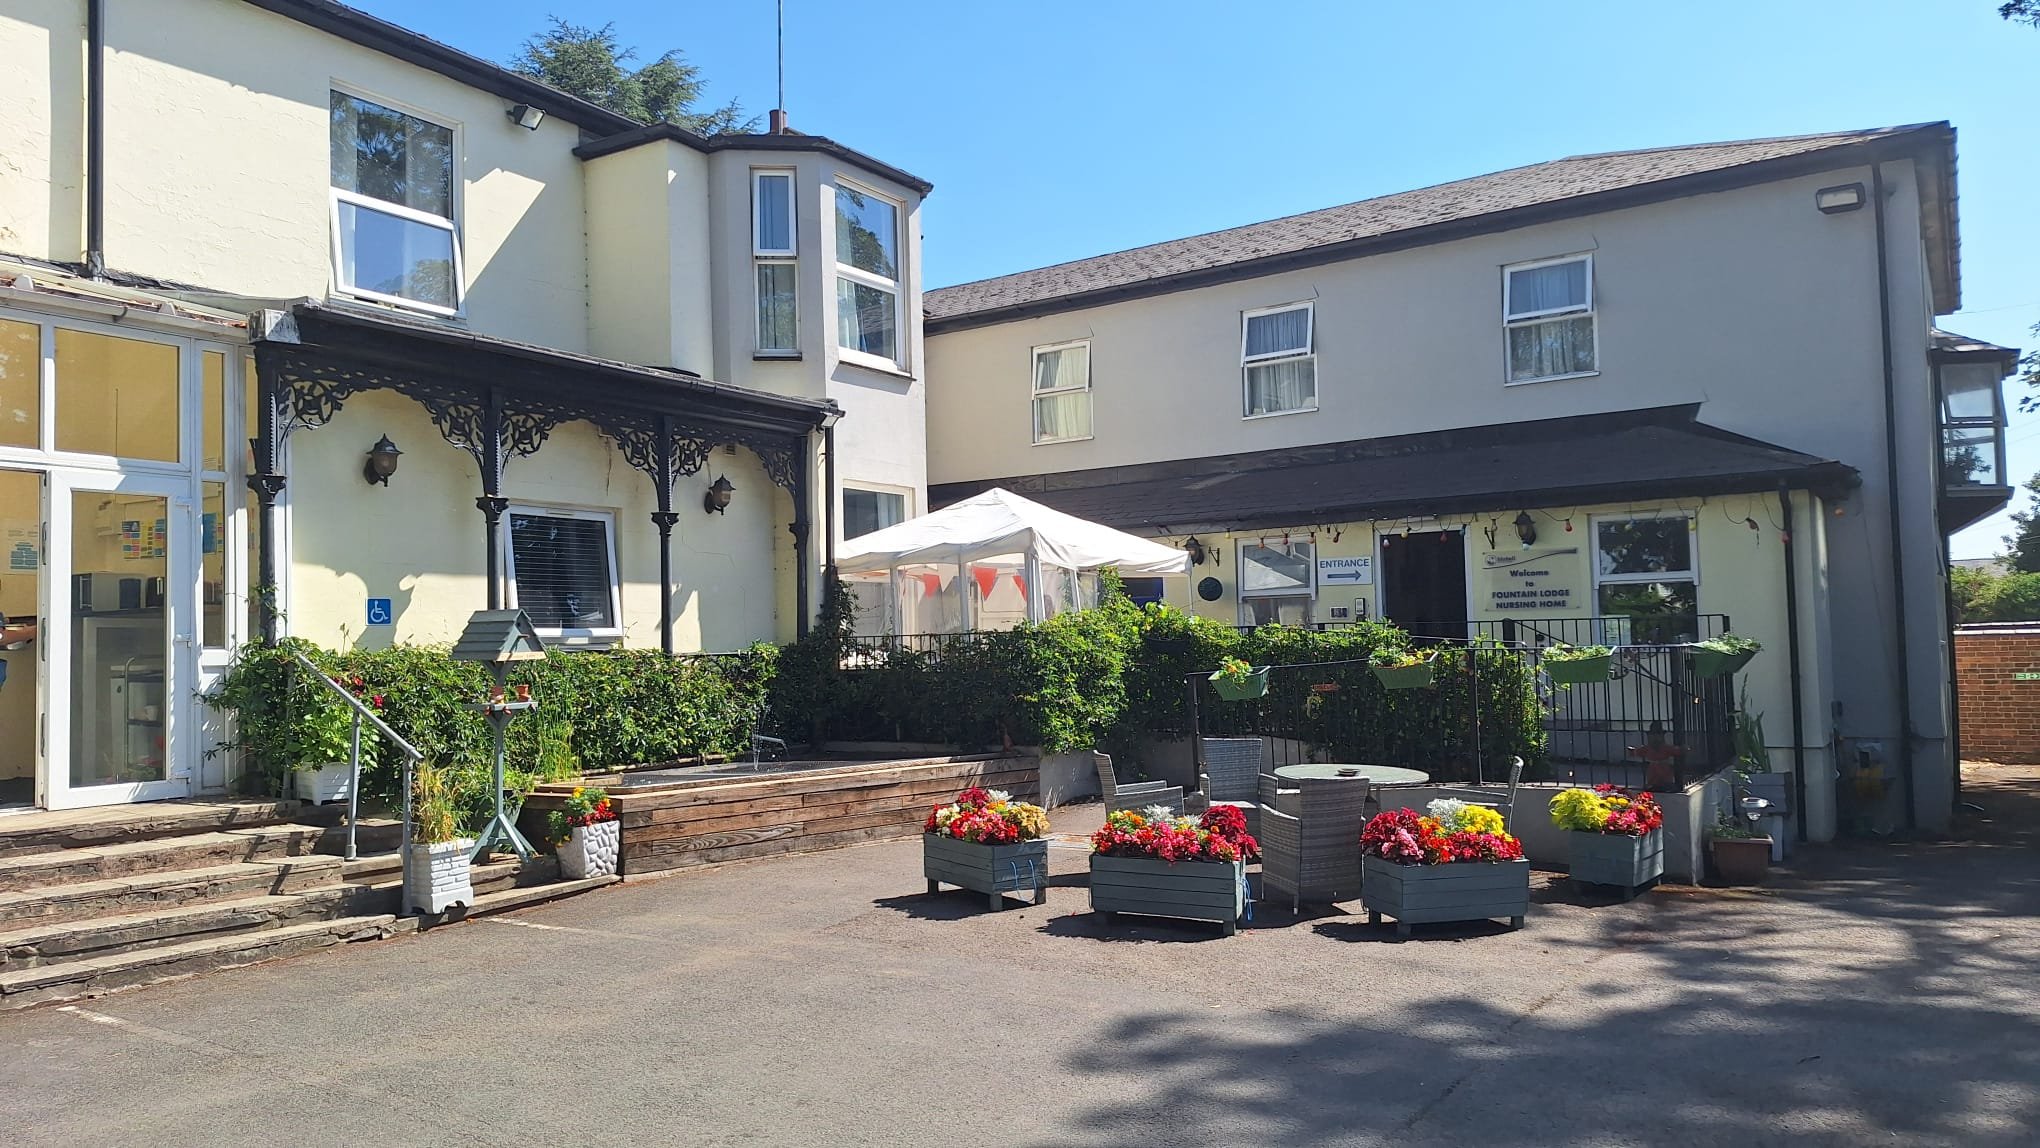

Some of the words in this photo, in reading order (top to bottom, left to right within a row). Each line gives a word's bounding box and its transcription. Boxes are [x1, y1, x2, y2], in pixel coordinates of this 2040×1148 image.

[1320, 559, 1369, 568] ENTRANCE
[1510, 569, 1549, 577] Welcome
[1492, 590, 1537, 599] FOUNTAIN
[1540, 589, 1570, 597] LODGE
[1496, 601, 1536, 609] NURSING
[1539, 600, 1567, 608] HOME
